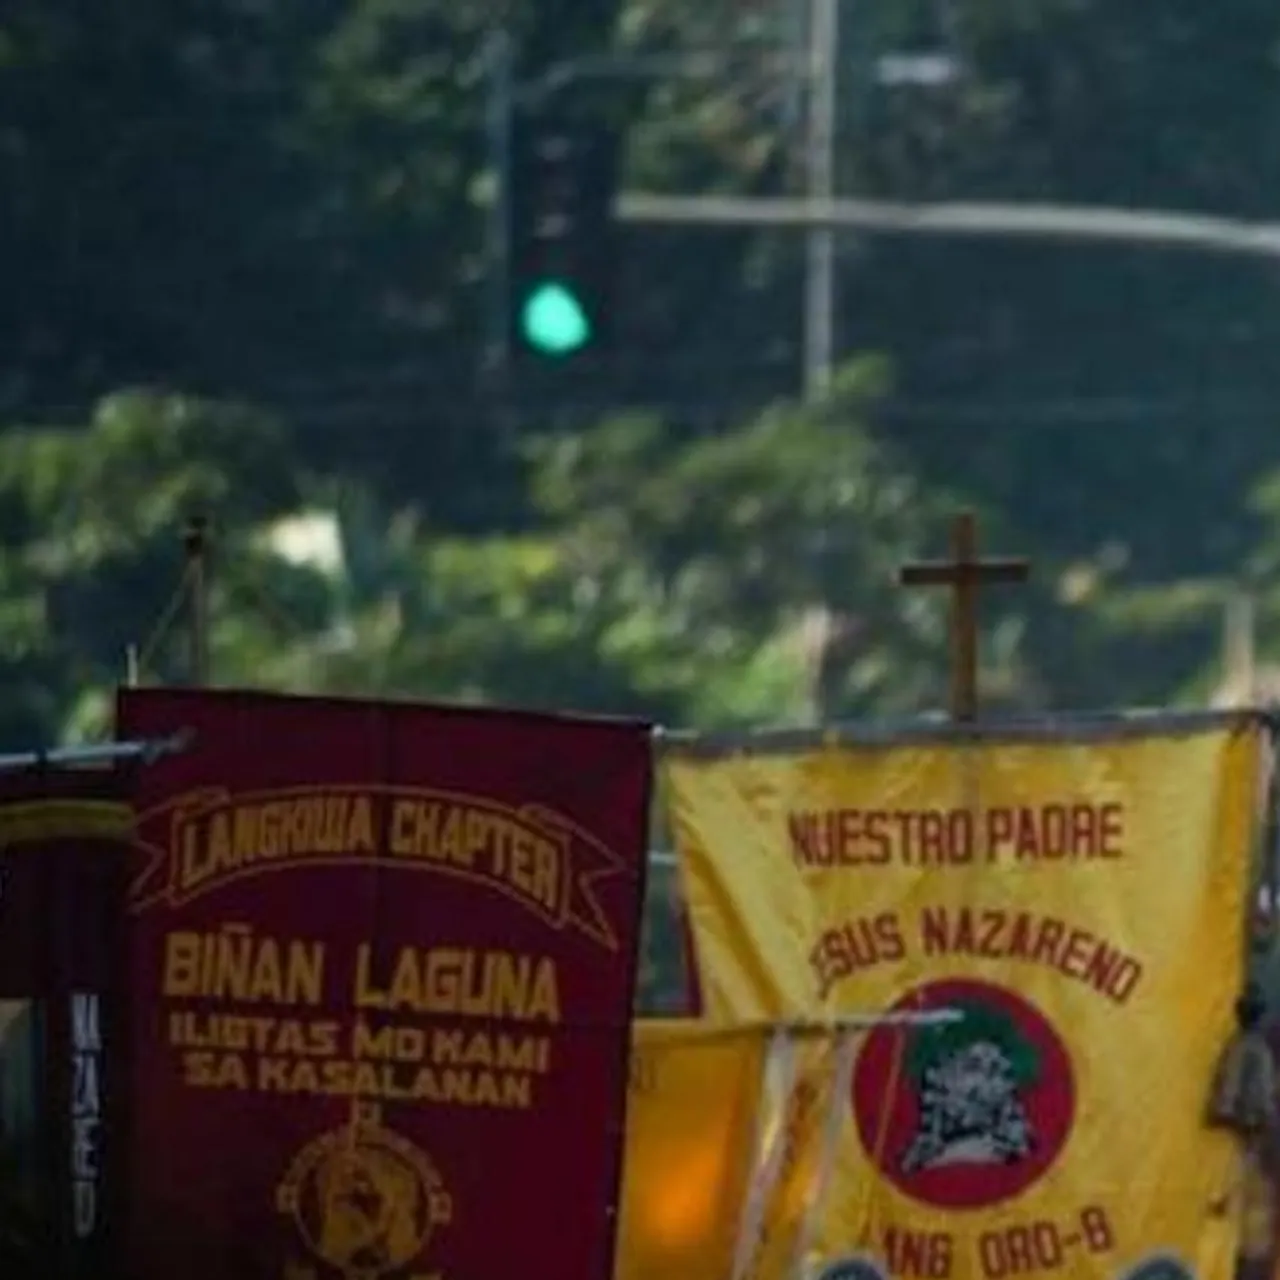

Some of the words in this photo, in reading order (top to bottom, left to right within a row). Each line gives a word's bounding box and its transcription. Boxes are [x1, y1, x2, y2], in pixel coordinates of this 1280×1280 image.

[180, 794, 374, 890] LANGKIWA
[387, 798, 559, 909] CHAPTER
[788, 808, 973, 866] NUESTRO
[986, 803, 1124, 862] PADRE
[162, 921, 325, 1005] BIÑAN
[353, 942, 561, 1025] LAGUNA
[921, 906, 1143, 1004] NAZARENO
[256, 1055, 533, 1109] KASALANAN
[352, 1012, 425, 1062] MO
[431, 1028, 552, 1075] KAMI
